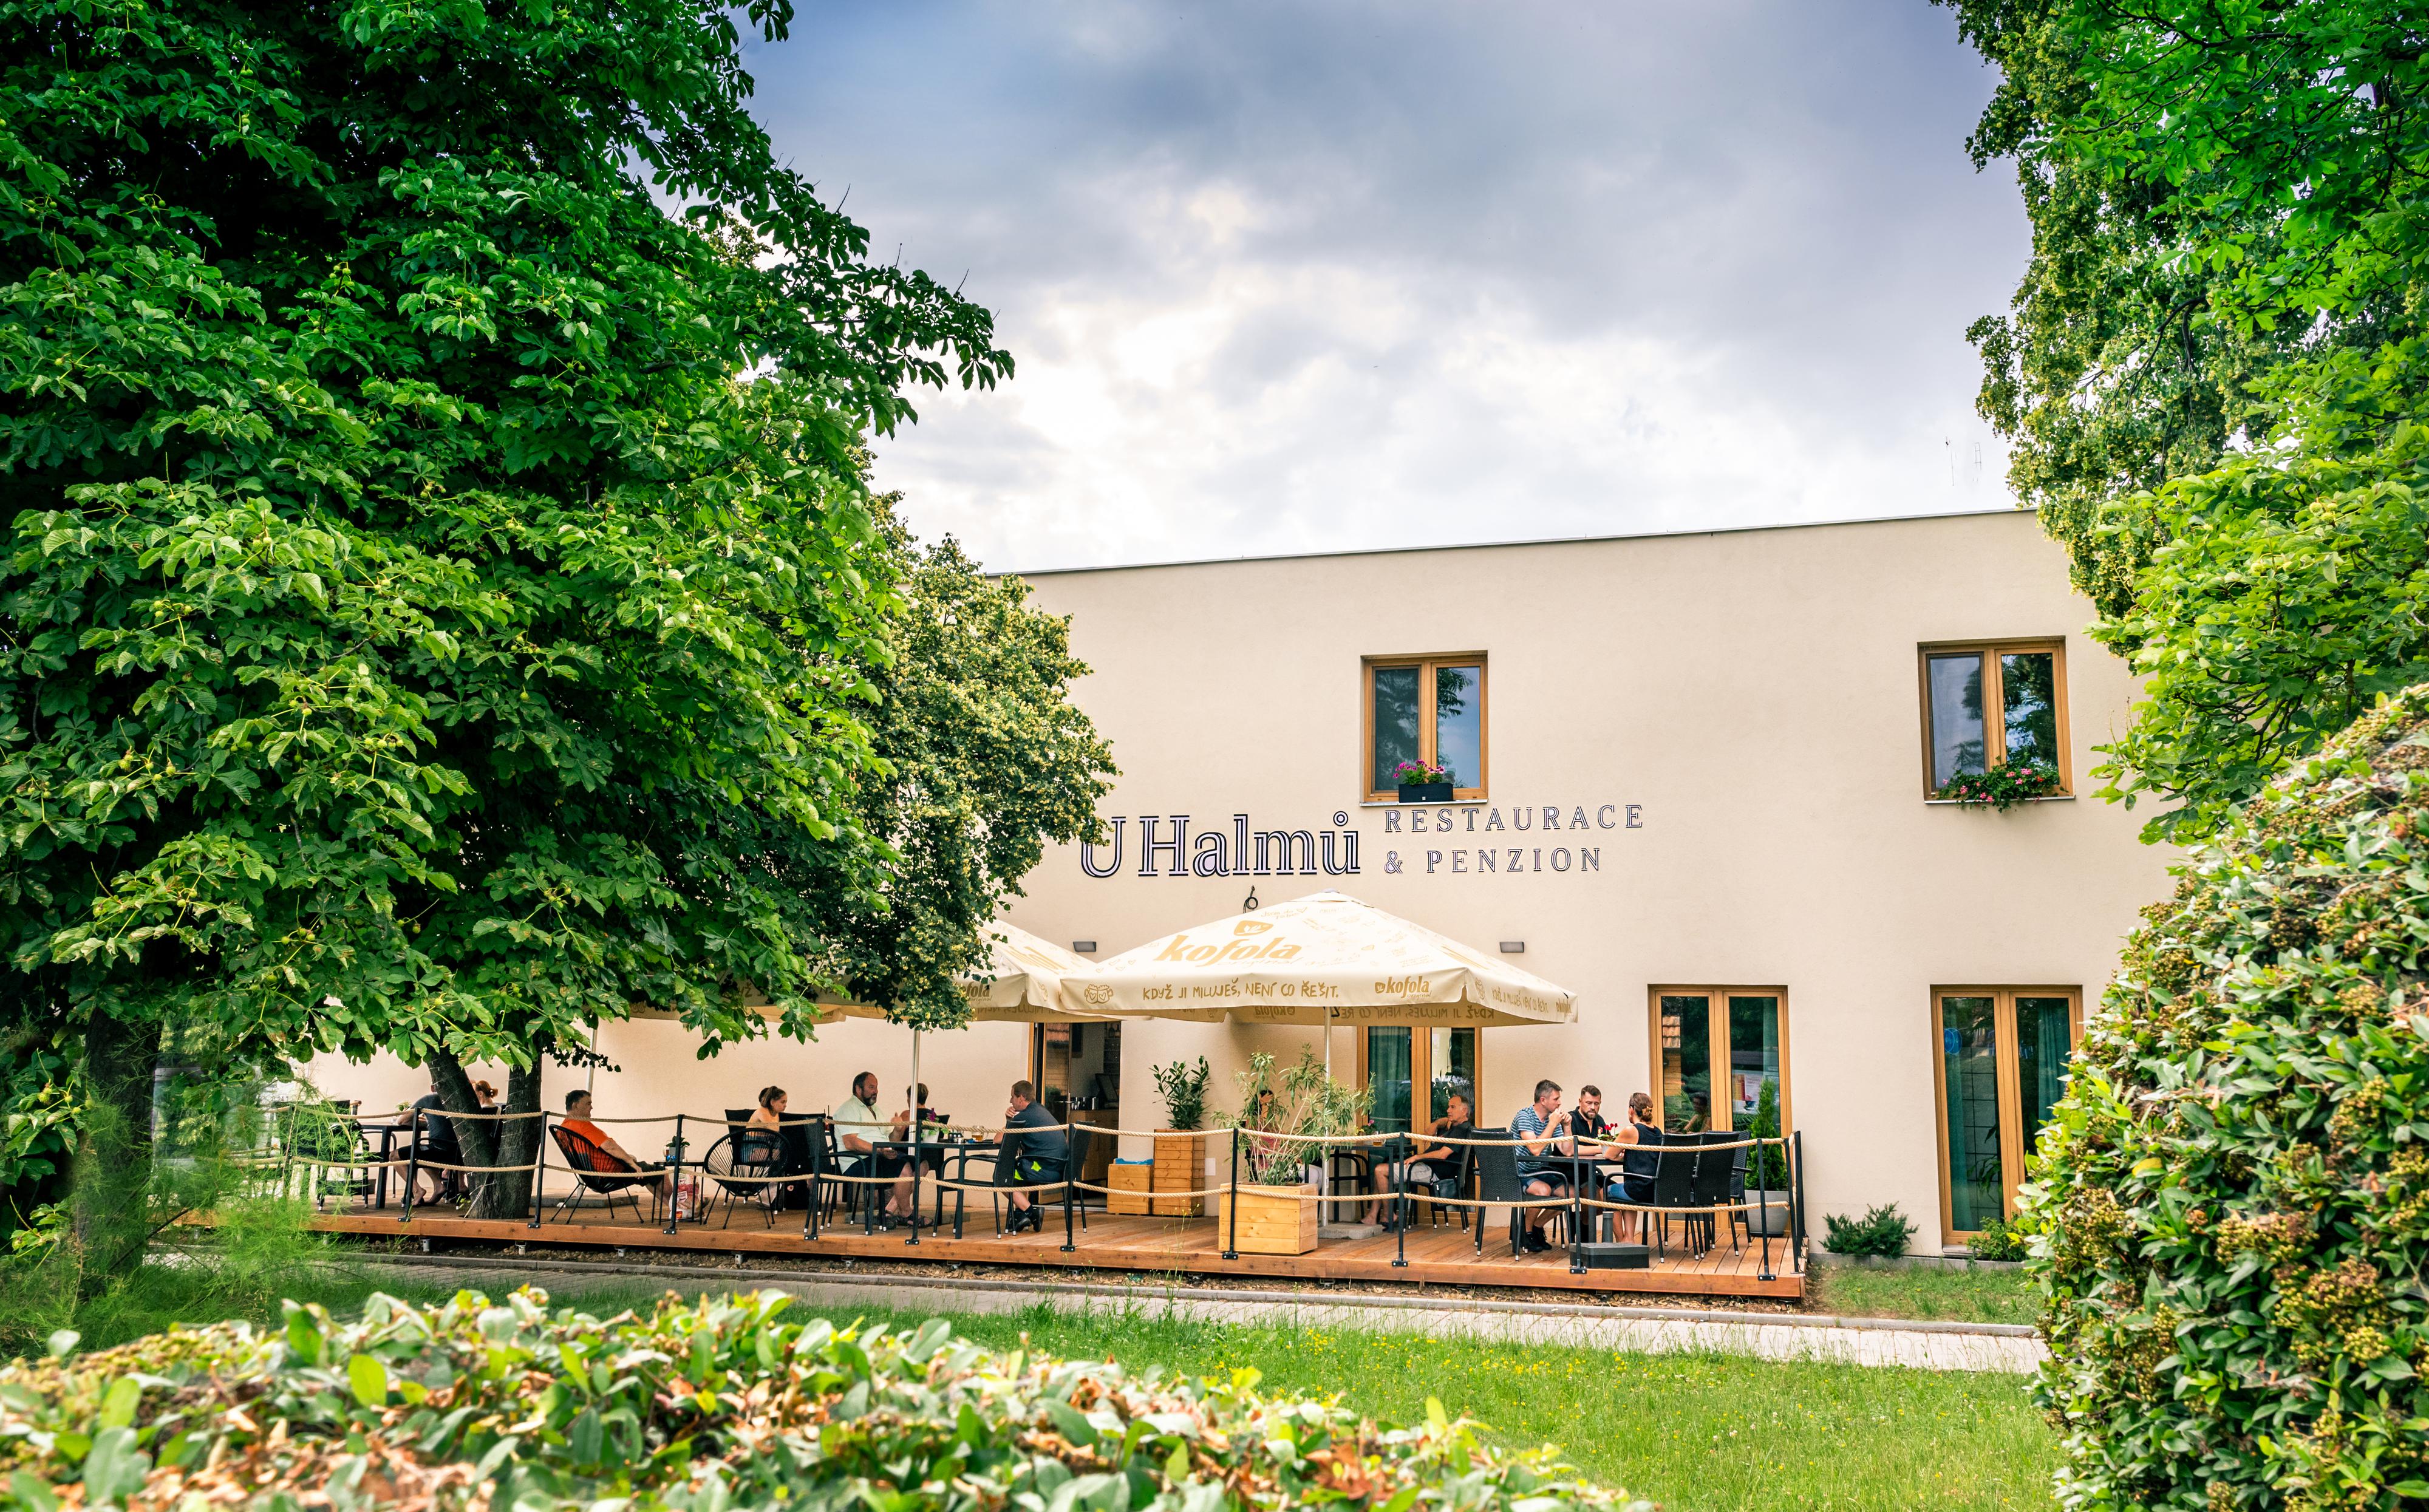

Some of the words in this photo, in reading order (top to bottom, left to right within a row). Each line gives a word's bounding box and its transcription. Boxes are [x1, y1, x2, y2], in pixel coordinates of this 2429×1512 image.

[1385, 805, 1643, 833] RESTAURACE
[1081, 816, 1126, 878] U
[1138, 811, 1361, 877] Halmů
[1384, 850, 1403, 874] &
[1426, 848, 1600, 874] PENZION
[1153, 935, 1303, 967] kofola
[962, 981, 990, 998] fola
[1143, 984, 1173, 1000] KDYŽ
[1178, 986, 1187, 999] JI
[1193, 977, 1241, 999] MILUJEŠ,
[1245, 982, 1278, 998] NENÍ
[1281, 983, 1295, 996] CO
[1301, 980, 1339, 999] ŘEŠIT.
[1385, 975, 1429, 998] kofola
